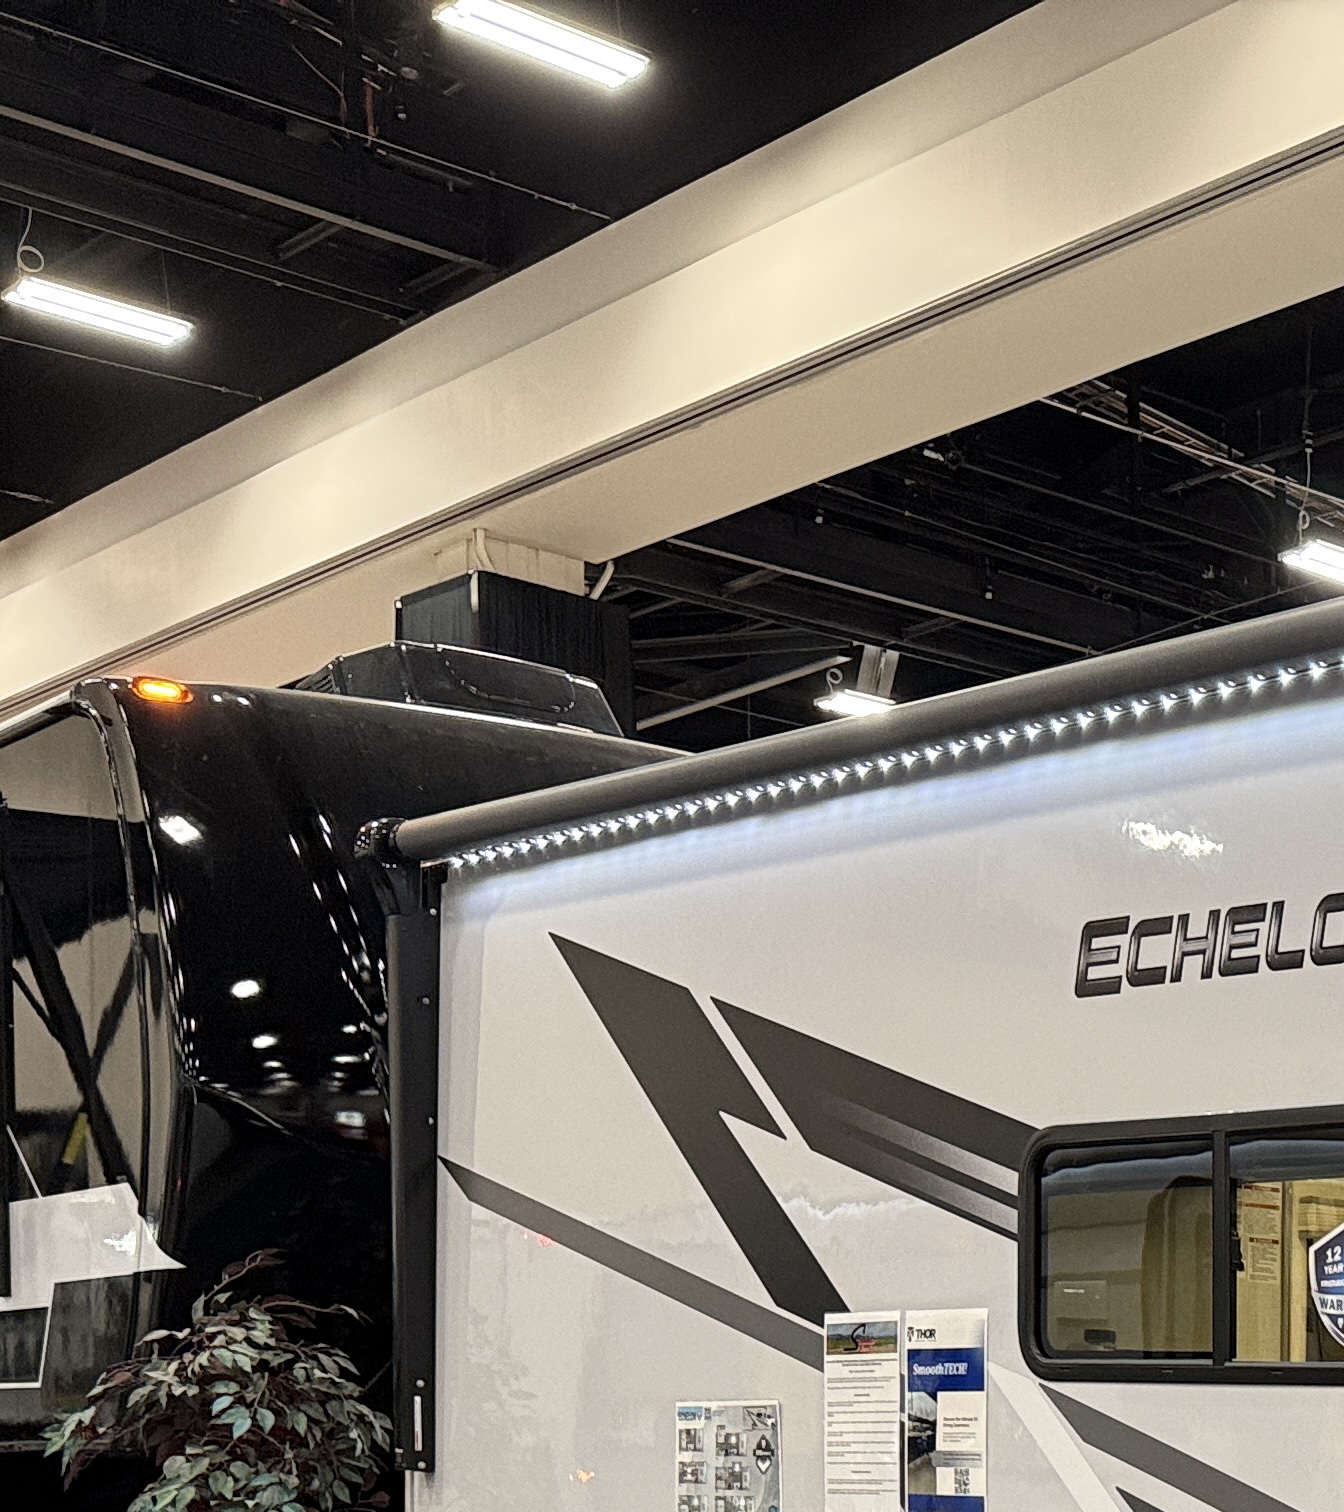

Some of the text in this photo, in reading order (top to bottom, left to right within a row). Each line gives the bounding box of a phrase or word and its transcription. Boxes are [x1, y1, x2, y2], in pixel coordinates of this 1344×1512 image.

[1325, 1245, 1342, 1264] 12
[1324, 1263, 1344, 1275] YEAR
[915, 1328, 937, 1340] THOR
